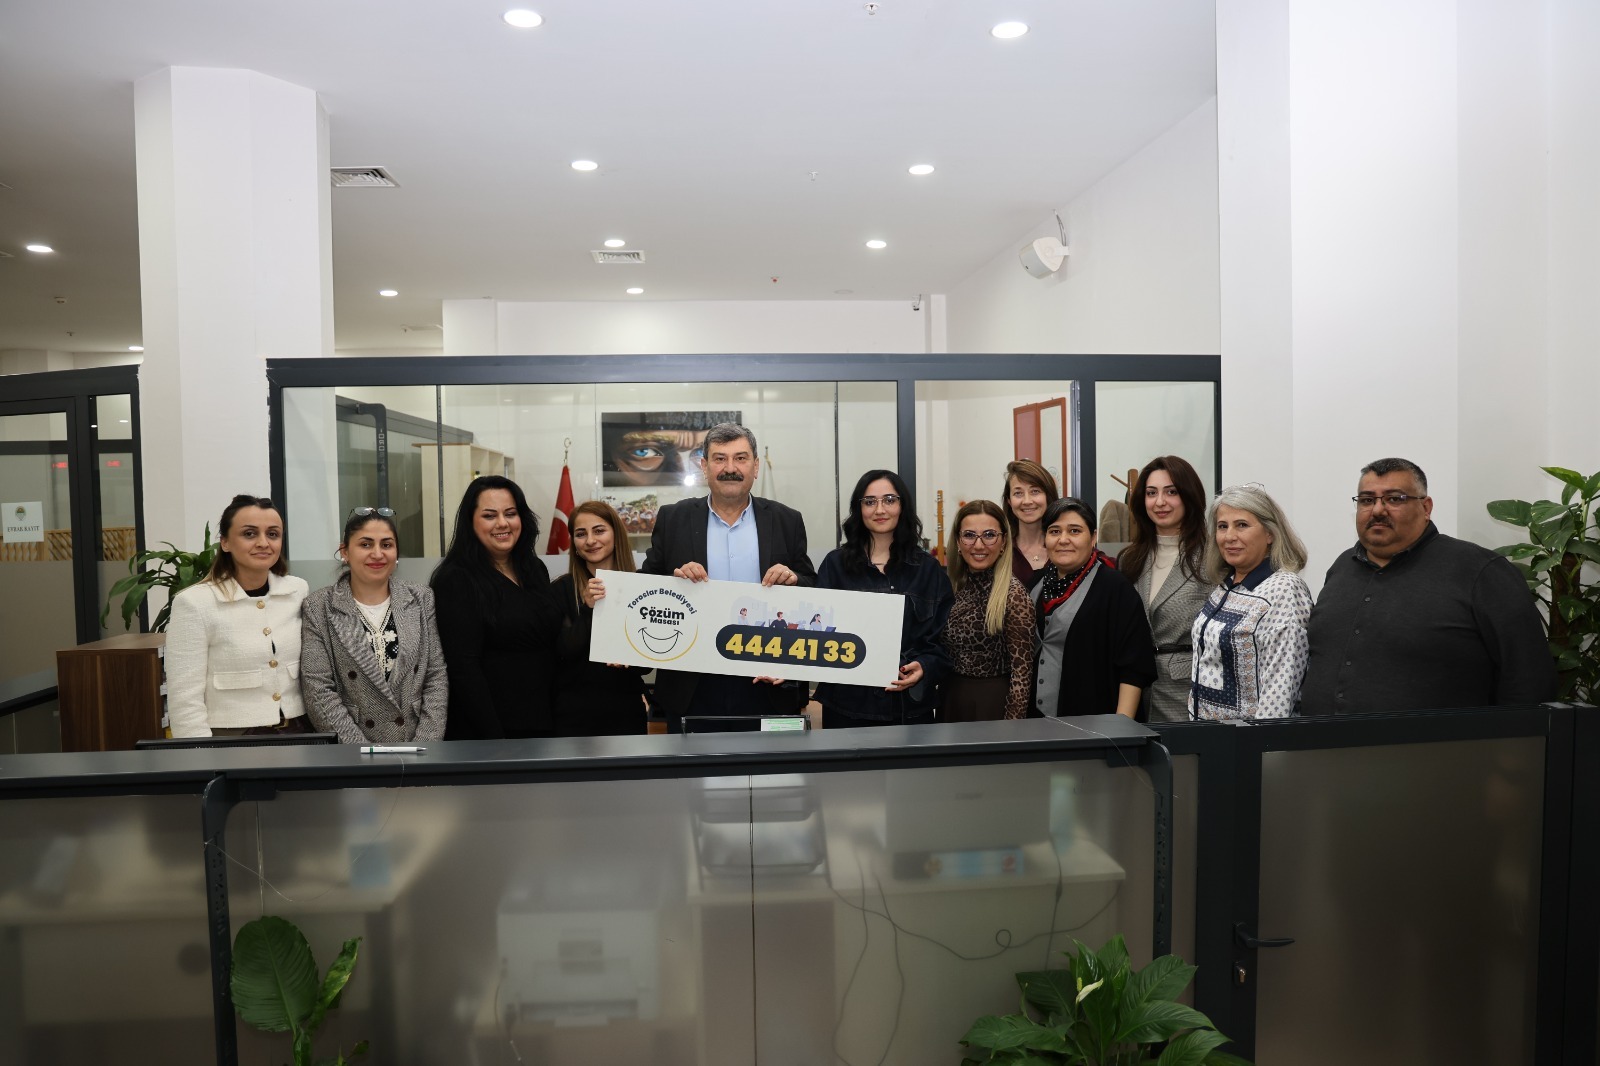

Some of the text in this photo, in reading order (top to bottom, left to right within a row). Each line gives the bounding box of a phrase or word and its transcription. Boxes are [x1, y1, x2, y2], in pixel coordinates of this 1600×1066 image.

[627, 588, 698, 615] Toroslar Belediyesi
[639, 606, 685, 620] Çözüm
[650, 617, 680, 625] Masası
[725, 633, 783, 658] 444
